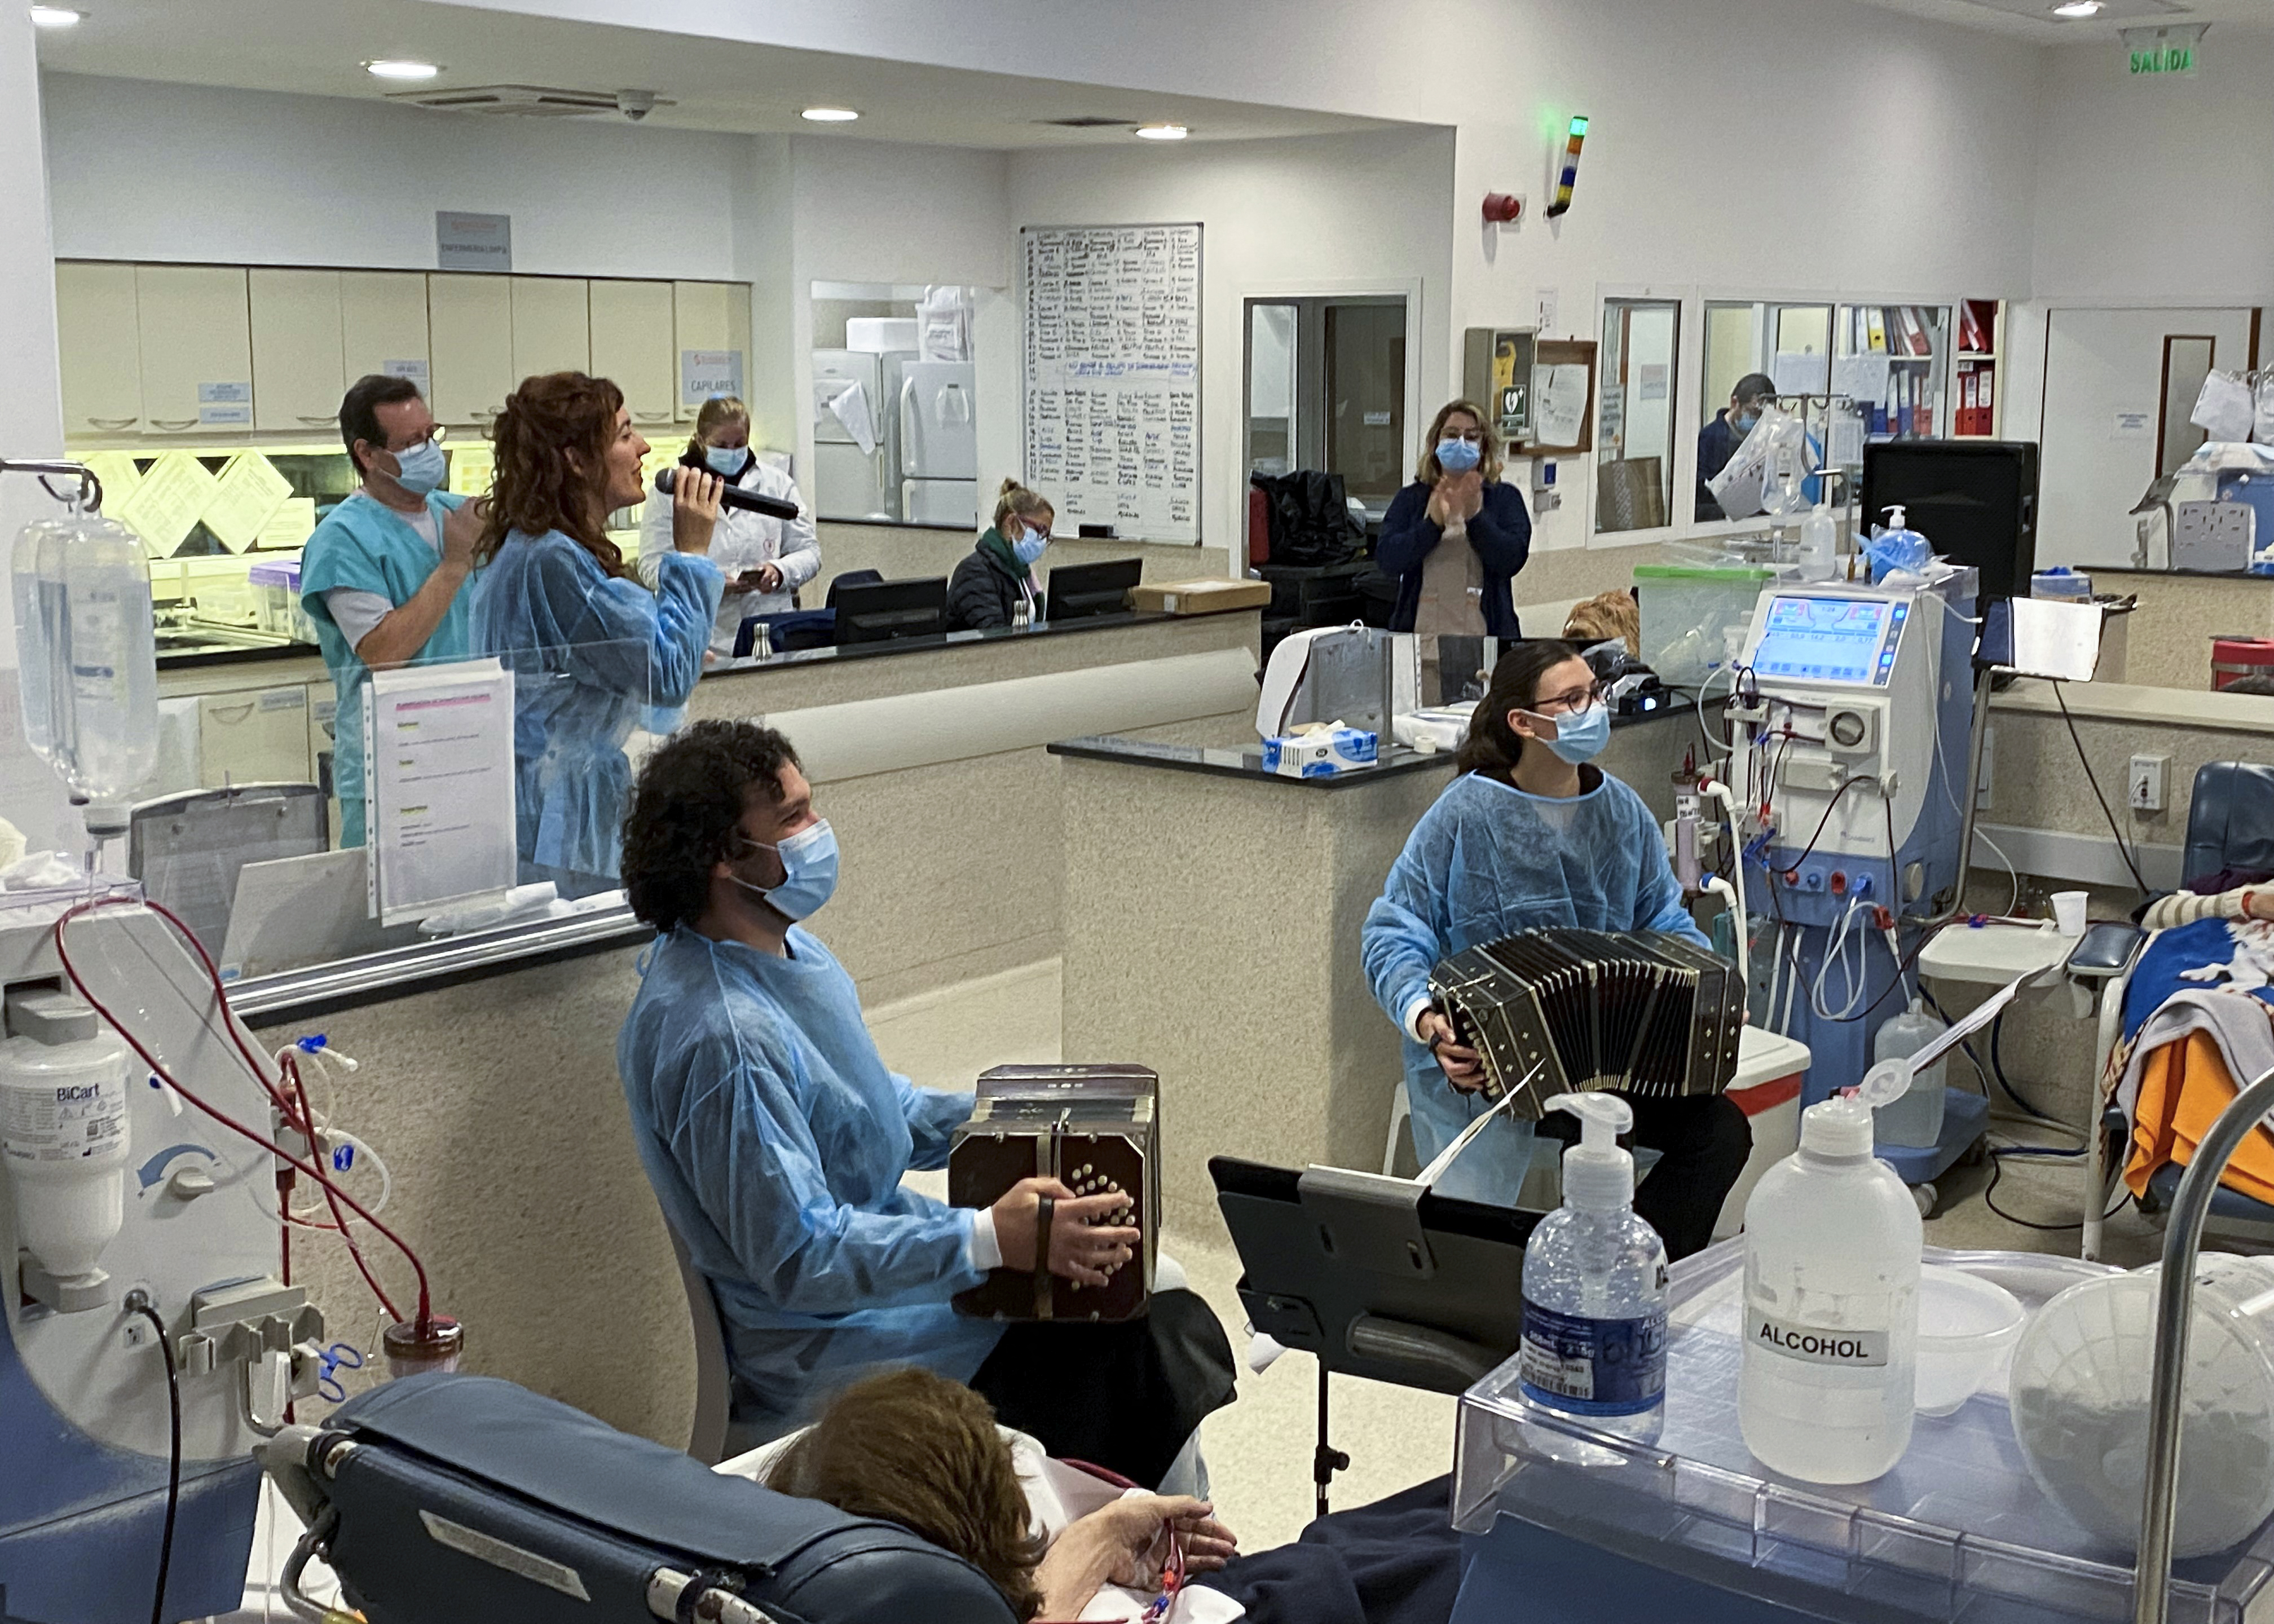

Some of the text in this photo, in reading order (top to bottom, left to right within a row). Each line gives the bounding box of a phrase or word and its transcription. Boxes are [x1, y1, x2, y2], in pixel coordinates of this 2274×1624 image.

[2130, 48, 2192, 74] SALIDA
[691, 379, 736, 392] CAPILARES
[57, 1083, 100, 1101] BiCart
[1760, 1322, 1869, 1358] ALCOHOL
